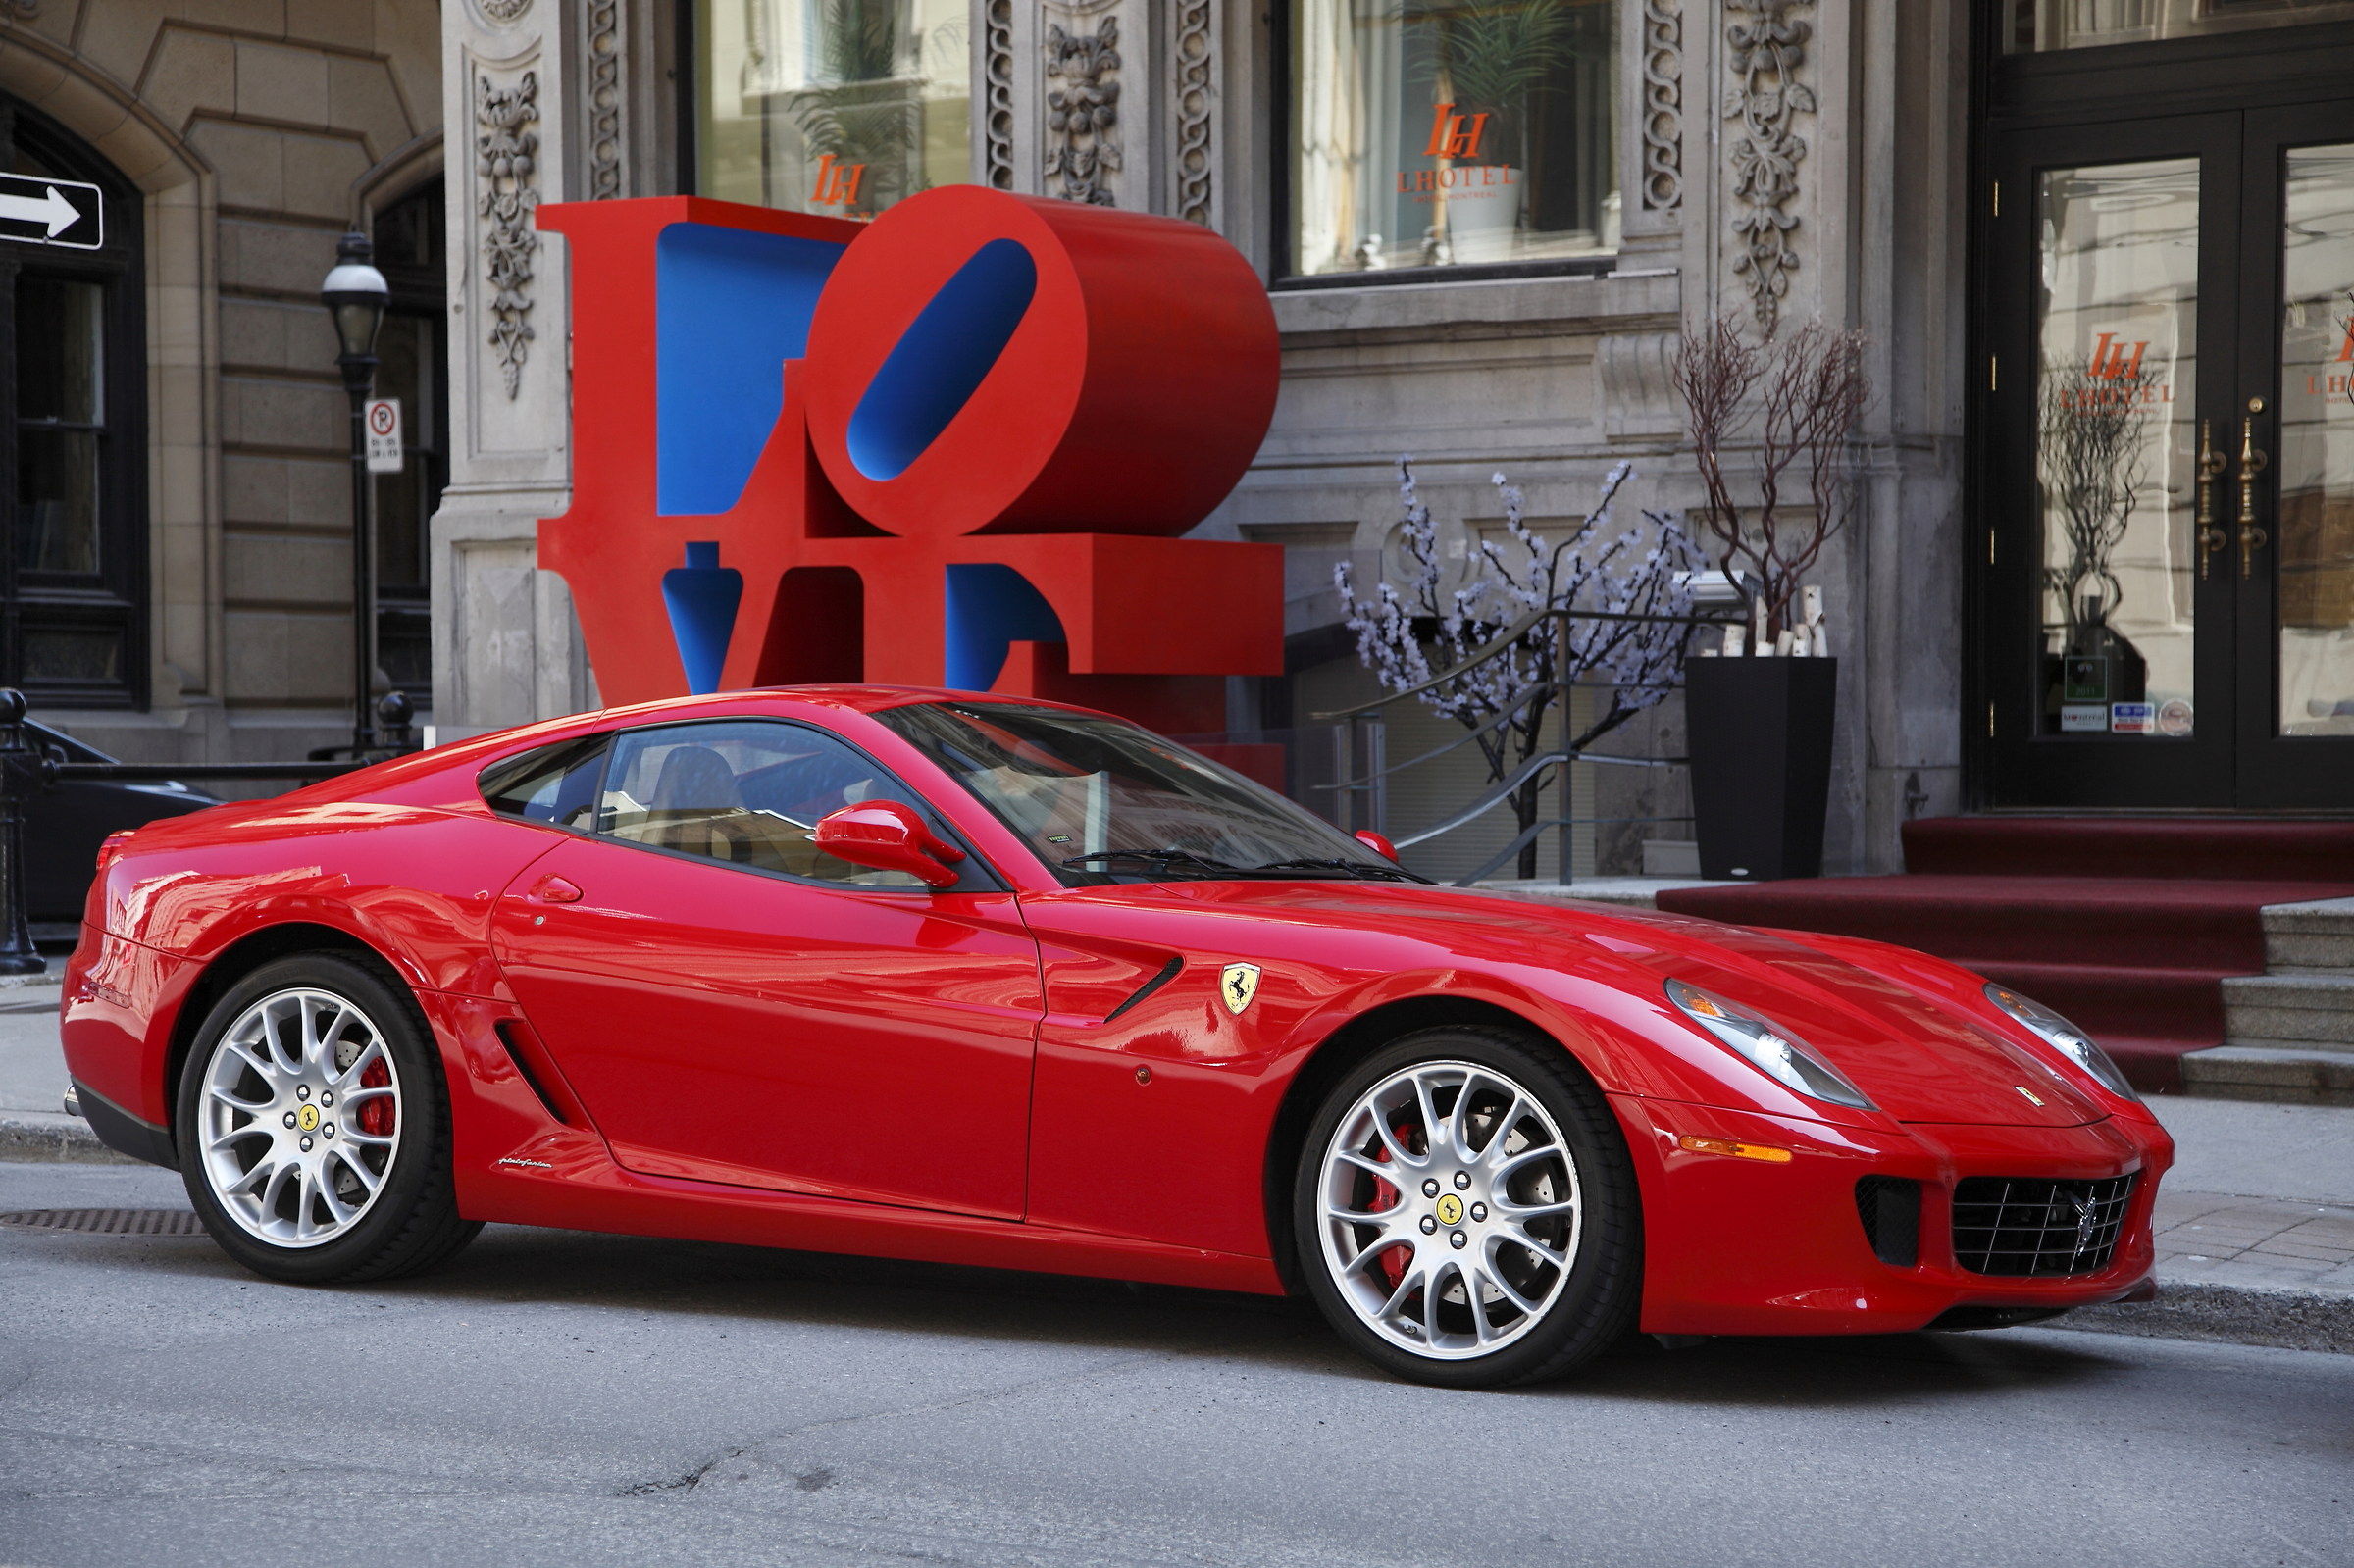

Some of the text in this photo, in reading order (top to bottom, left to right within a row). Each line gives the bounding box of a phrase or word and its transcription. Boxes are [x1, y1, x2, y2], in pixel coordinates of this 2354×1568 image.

[1397, 163, 1518, 193] LHOTEL
[2061, 384, 2175, 409] LHOTEL
[2075, 686, 2096, 696] 2011
